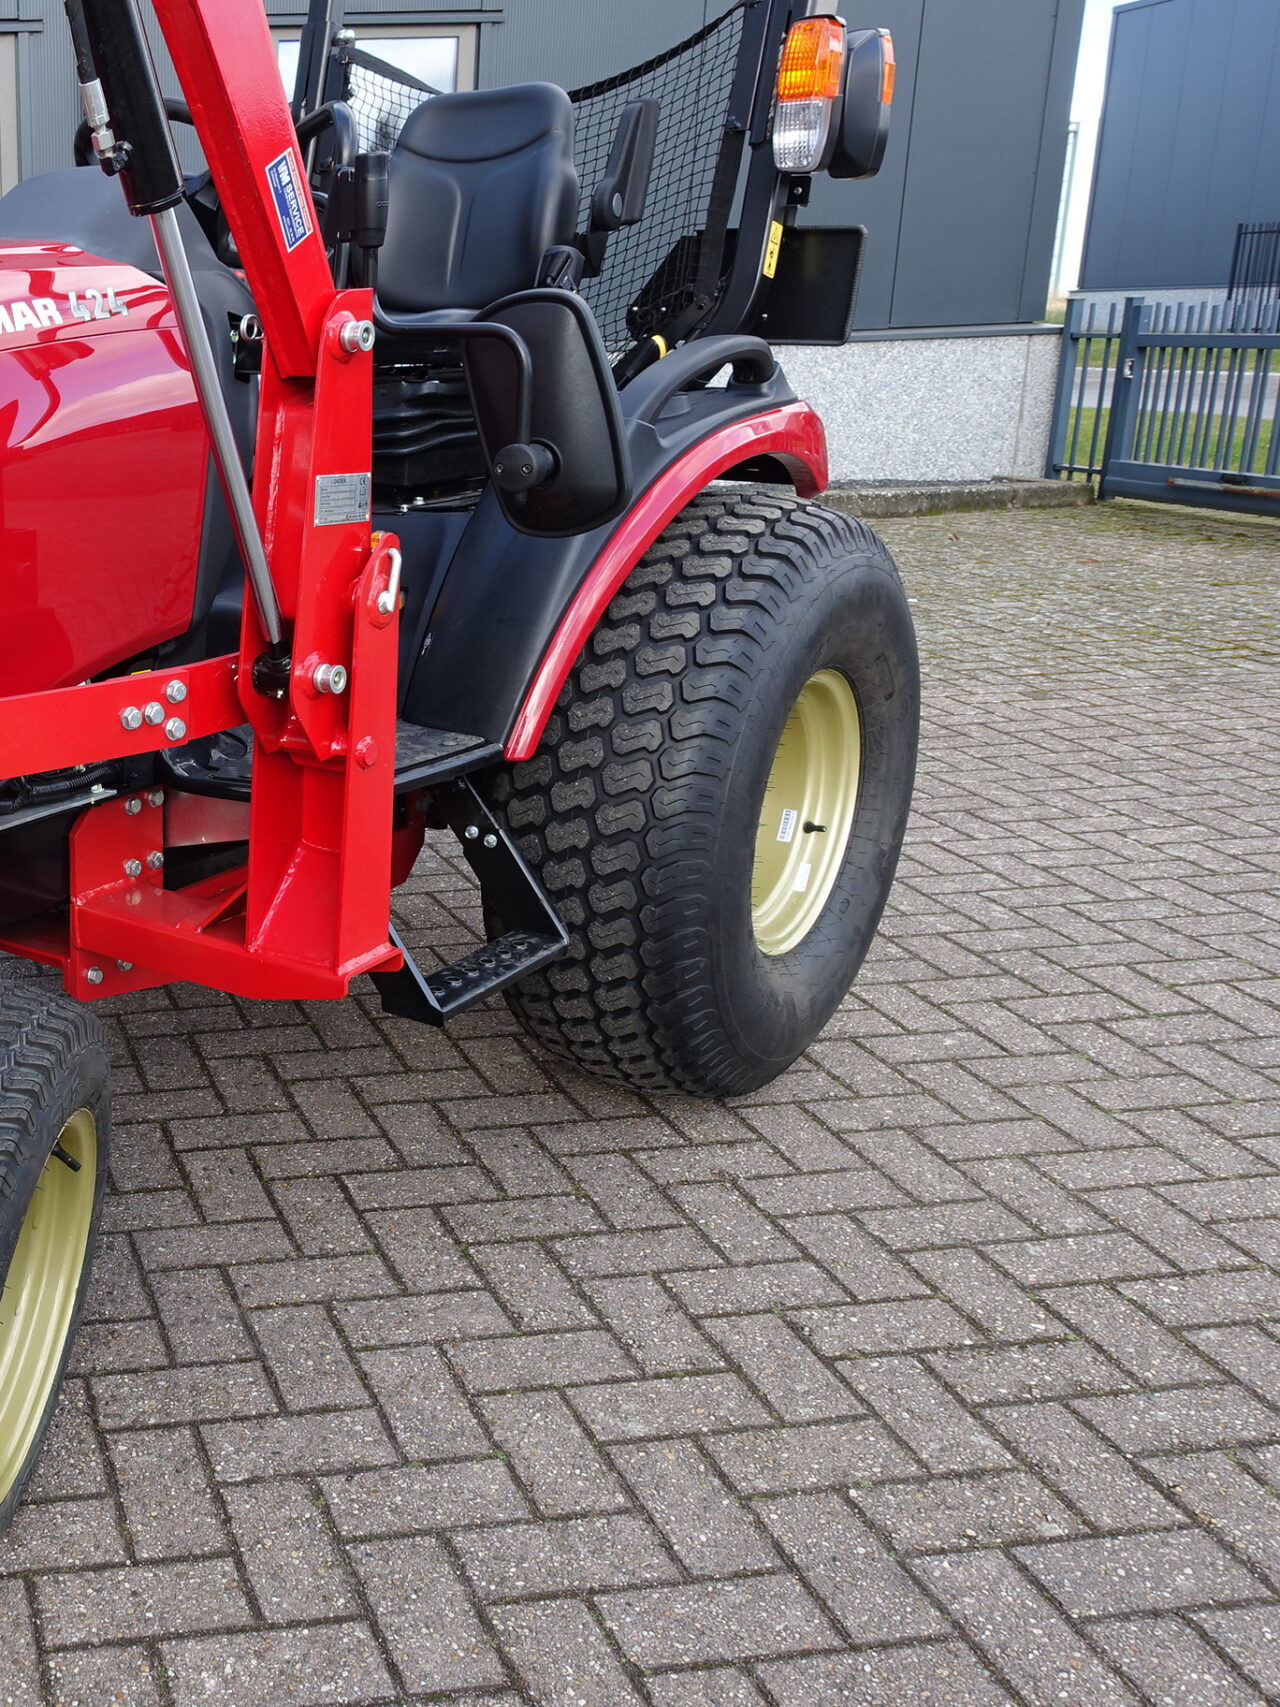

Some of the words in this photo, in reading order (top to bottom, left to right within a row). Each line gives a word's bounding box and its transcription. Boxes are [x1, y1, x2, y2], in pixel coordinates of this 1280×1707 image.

[277, 159, 291, 186] VM
[286, 183, 305, 237] SERVICE
[68, 286, 129, 322] 424
